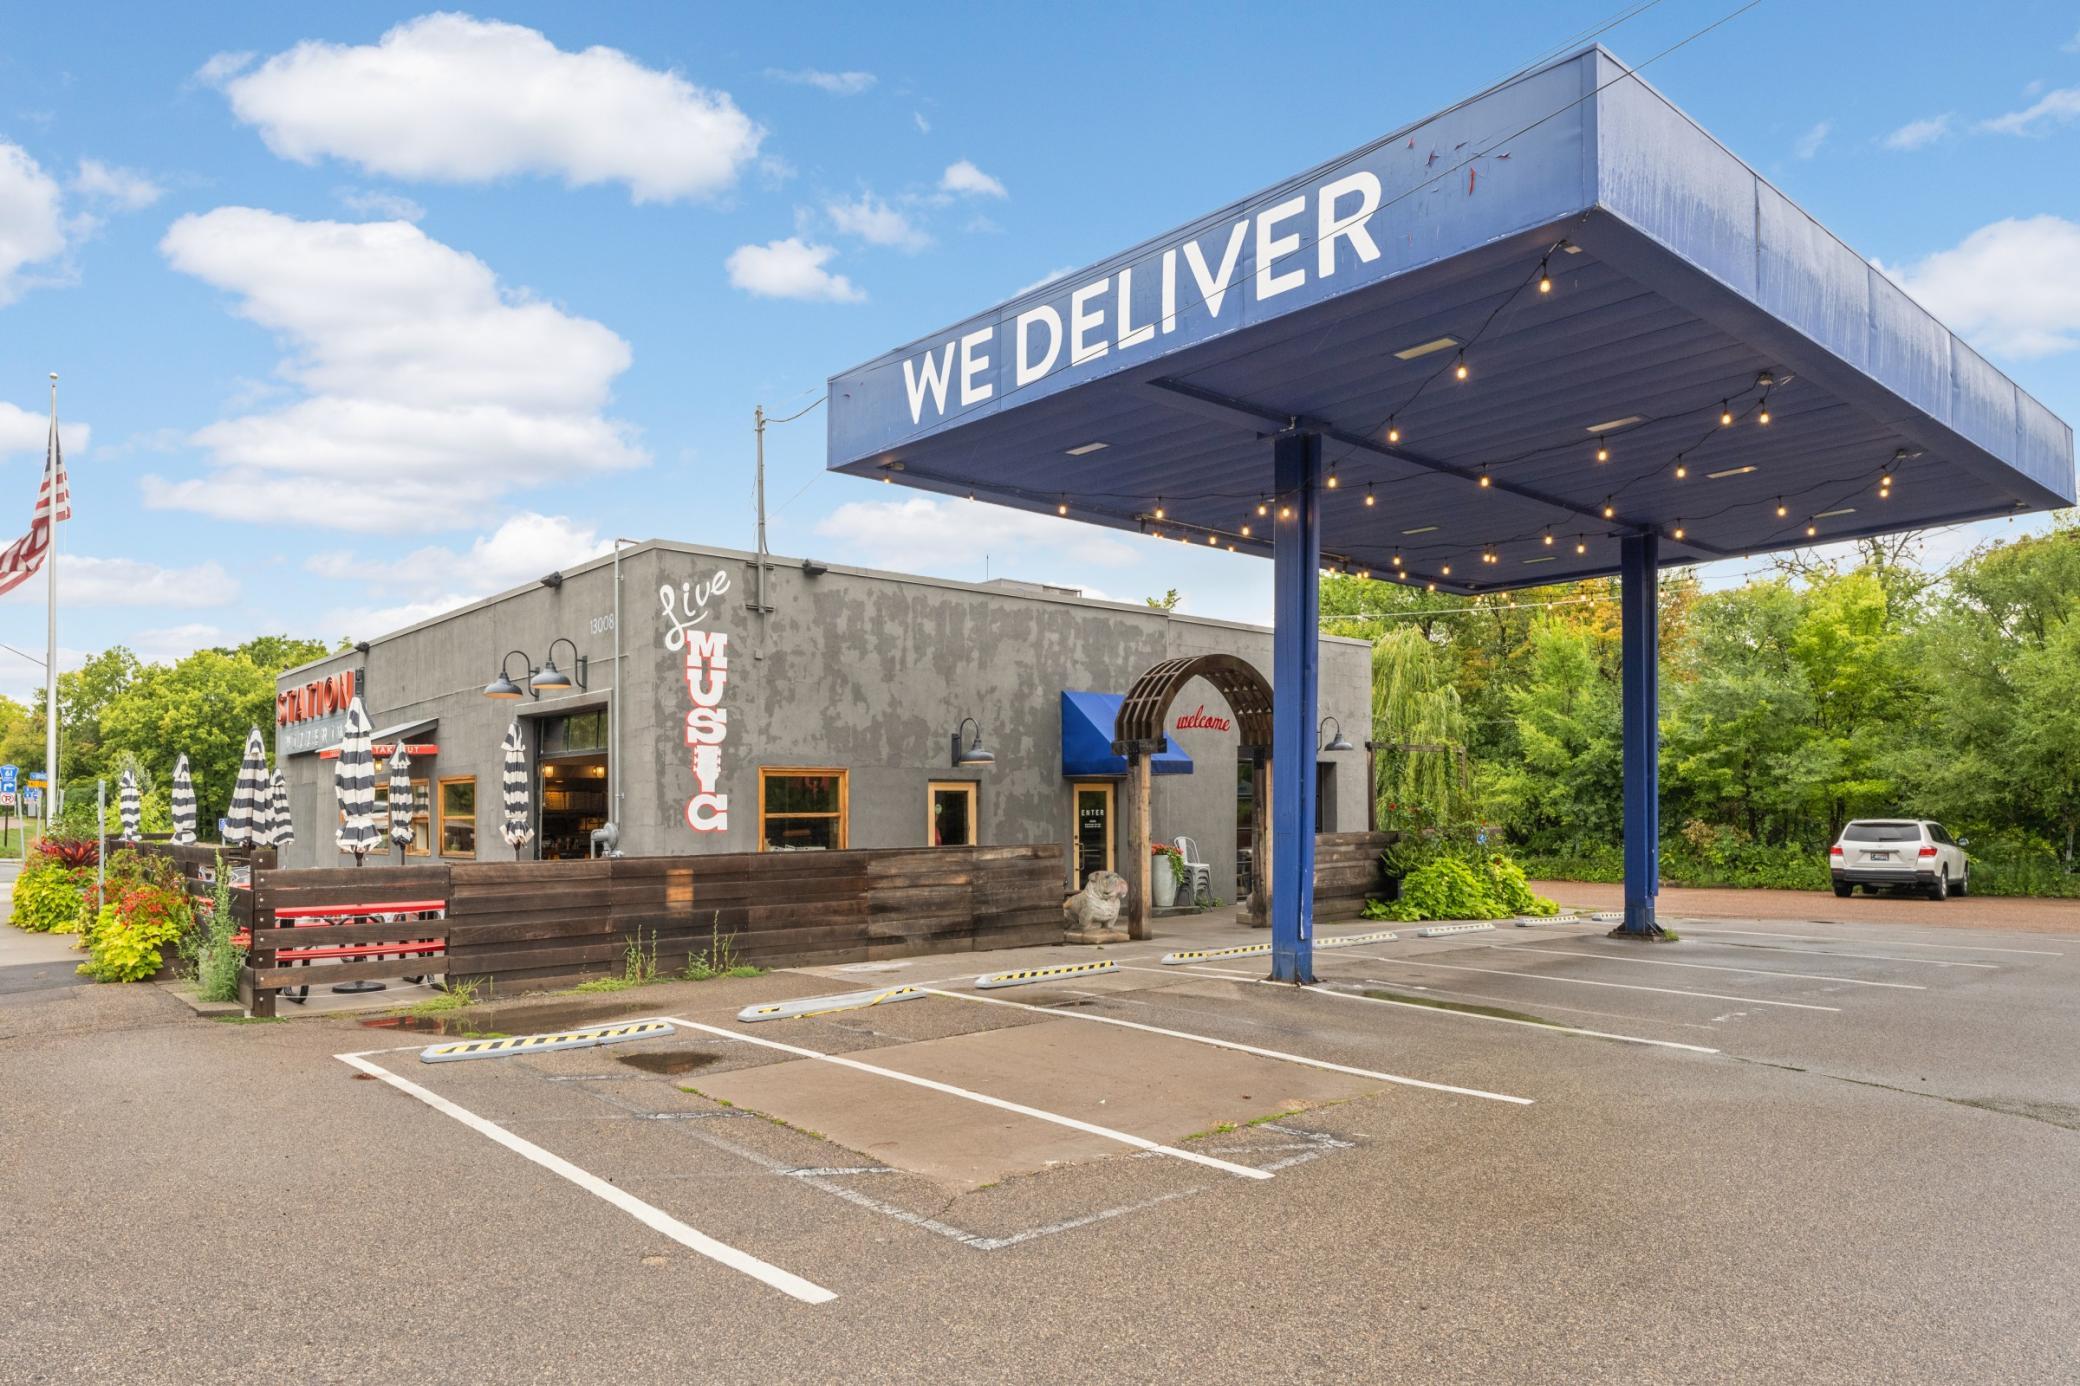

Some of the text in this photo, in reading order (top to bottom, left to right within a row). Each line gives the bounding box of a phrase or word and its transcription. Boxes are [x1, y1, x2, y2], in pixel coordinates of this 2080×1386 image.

[902, 171, 1382, 425] WE DELIVER
[590, 613, 614, 634] 13008
[660, 570, 731, 652] Live
[277, 671, 354, 726] STATION
[1176, 704, 1230, 731] welcome
[375, 746, 419, 754] TAKUT
[684, 629, 728, 832] MUSIC
